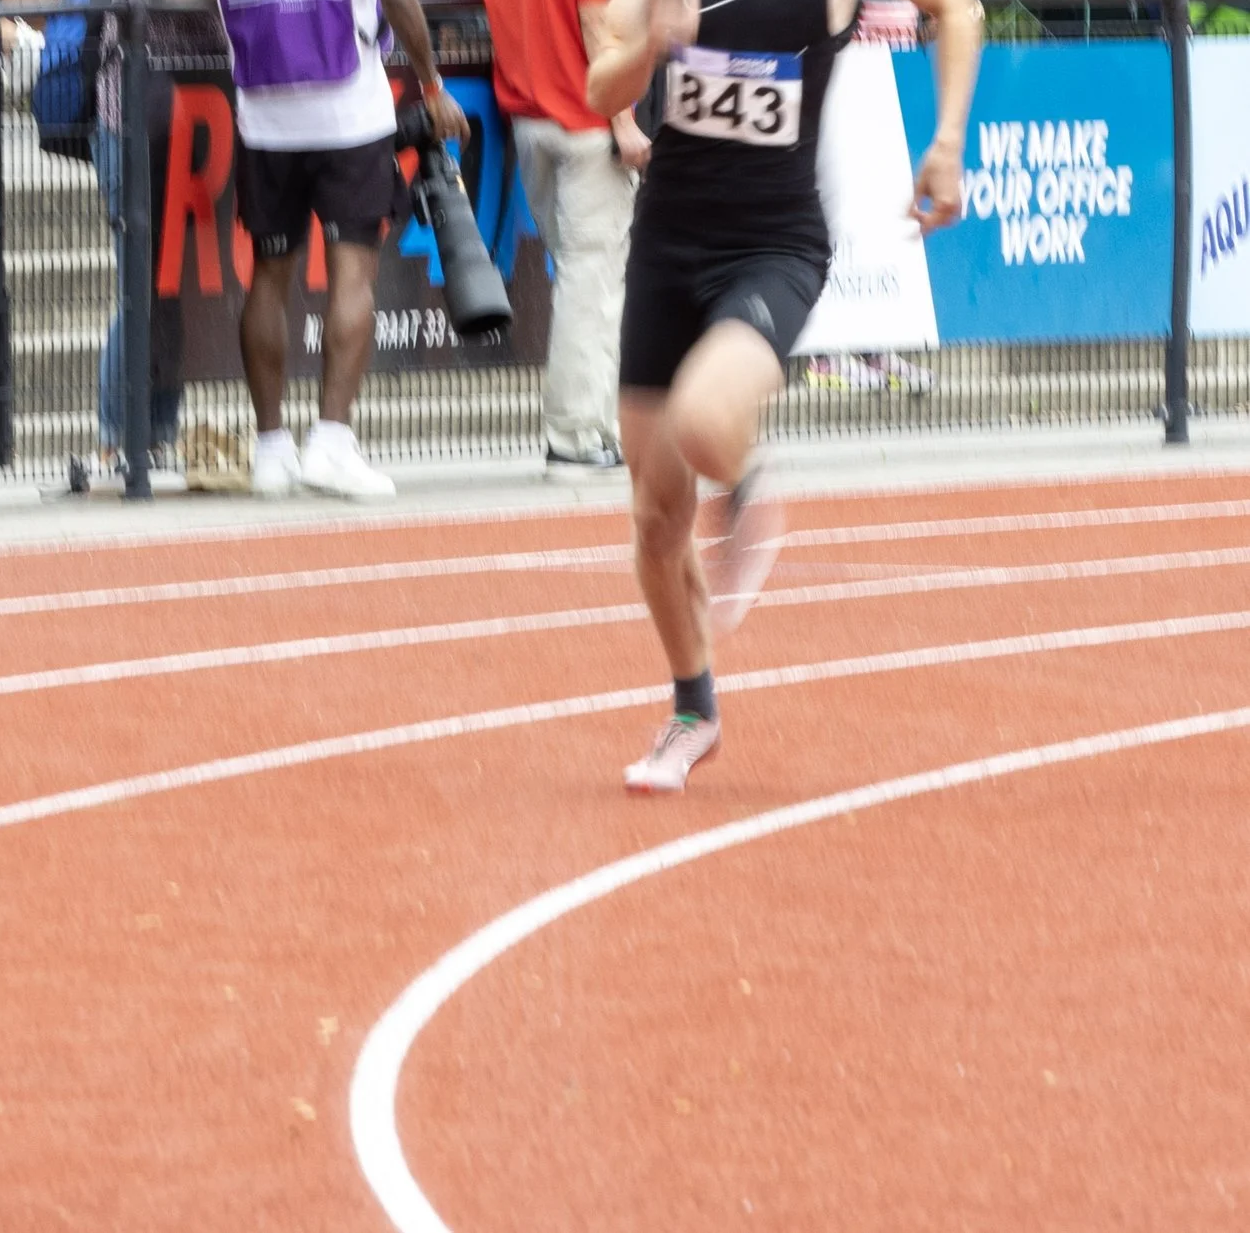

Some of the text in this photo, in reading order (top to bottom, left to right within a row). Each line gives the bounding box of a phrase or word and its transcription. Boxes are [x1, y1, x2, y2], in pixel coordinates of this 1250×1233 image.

[979, 119, 1109, 170] WE MAKE
[961, 165, 1133, 222] YOUR OFFICE
[999, 214, 1088, 268] WORK
